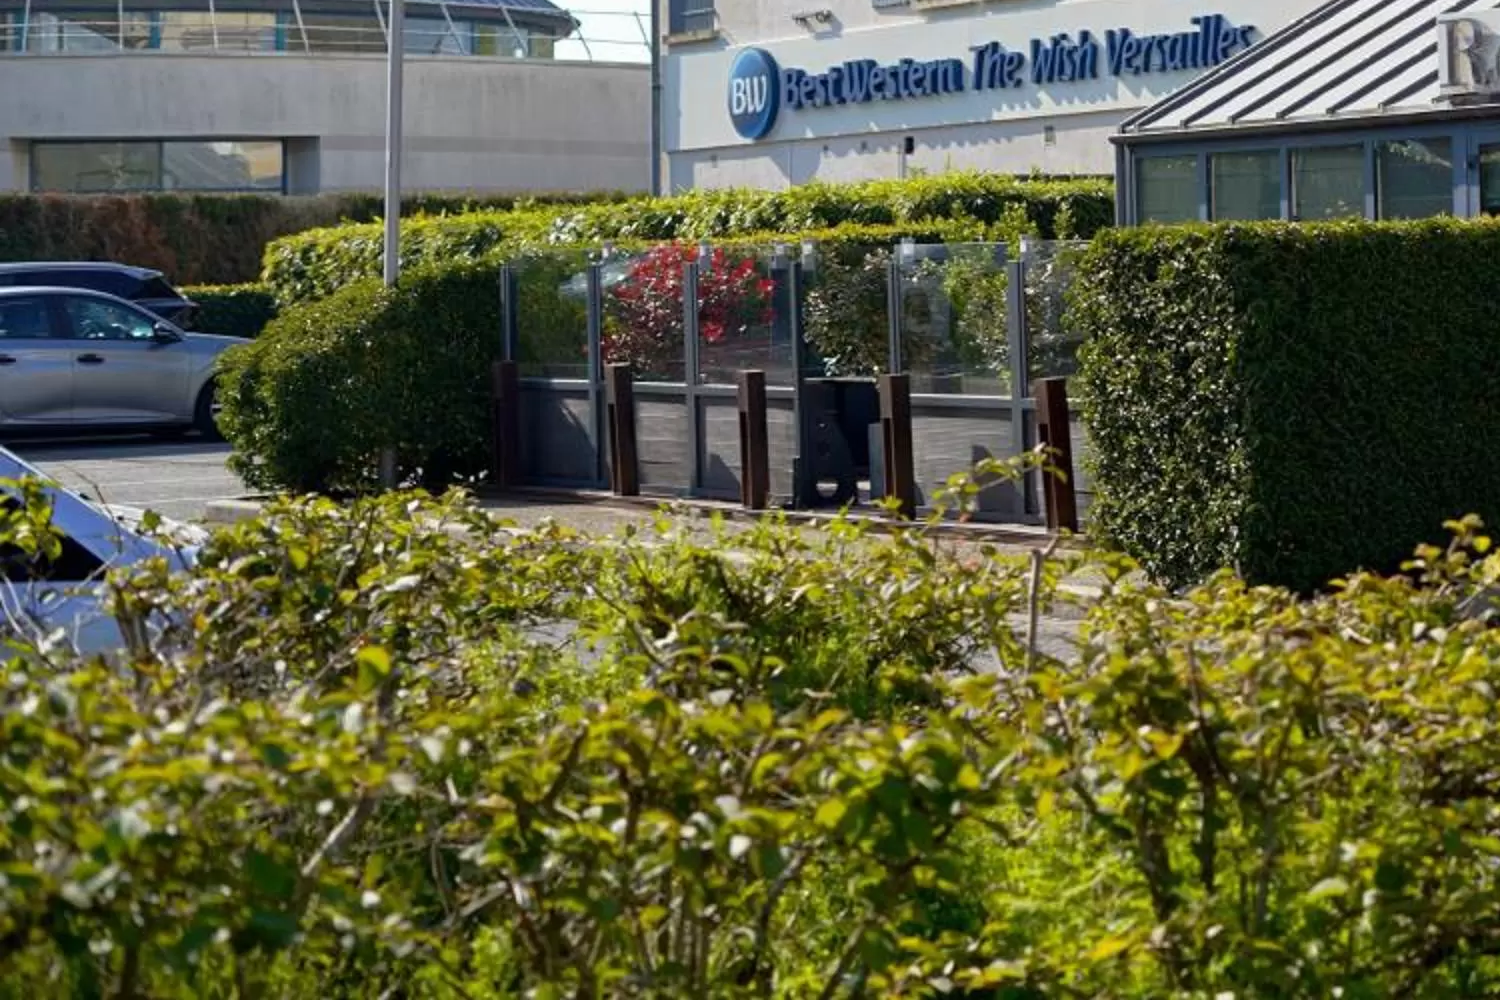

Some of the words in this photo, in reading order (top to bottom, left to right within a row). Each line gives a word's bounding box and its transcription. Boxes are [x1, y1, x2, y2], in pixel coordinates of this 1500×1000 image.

[731, 74, 768, 116] BW
[780, 67, 843, 111] Best
[842, 58, 965, 104] Western
[969, 40, 1026, 90] The
[1030, 29, 1099, 84] Wish
[1104, 14, 1256, 76] Versailles
